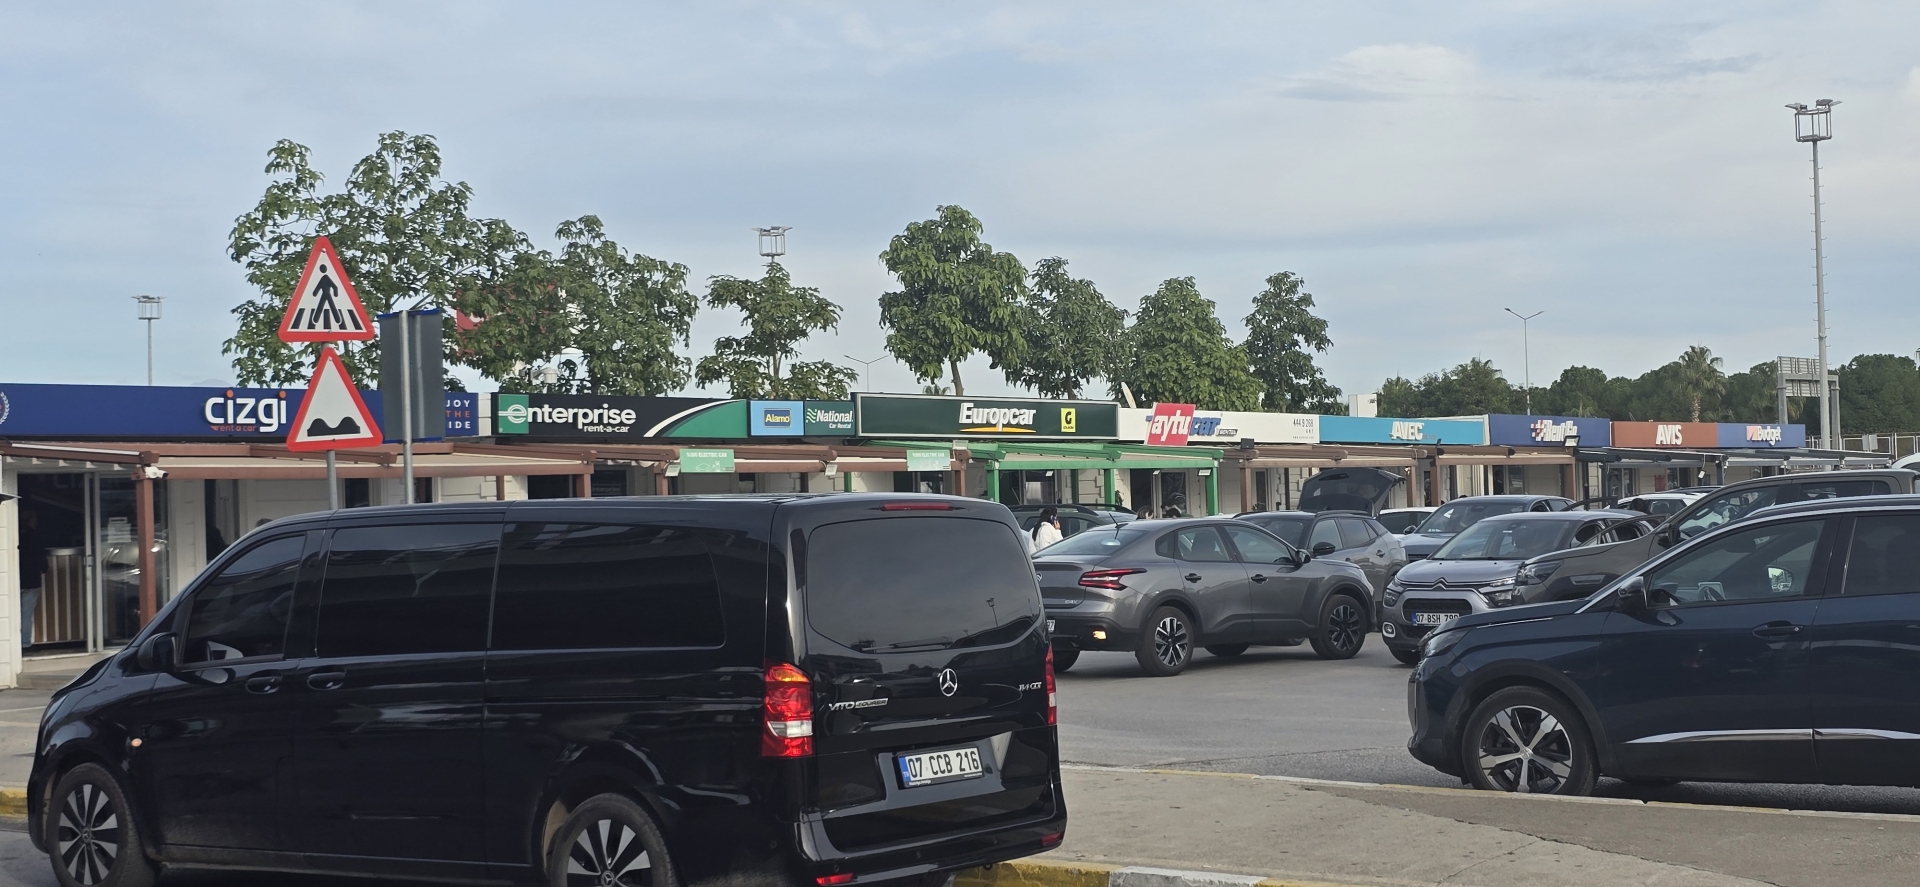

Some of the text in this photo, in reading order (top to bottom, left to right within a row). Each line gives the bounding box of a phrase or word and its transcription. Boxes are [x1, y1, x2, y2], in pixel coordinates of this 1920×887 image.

[204, 389, 287, 433] cizgi
[445, 410, 471, 418] THE
[499, 403, 637, 429] enterprise
[765, 413, 790, 423] Alamo
[959, 402, 1037, 431] Europcar
[216, 424, 235, 432] rent
[243, 424, 257, 432] car
[448, 421, 471, 429] IDE
[583, 423, 630, 433] rent-a-car
[1390, 421, 1425, 440] AVEC
[1655, 425, 1683, 446] AVIS
[1757, 425, 1782, 446] Budget
[1416, 614, 1425, 623] 07
[1427, 614, 1440, 623] BSH
[828, 701, 855, 711] VITO
[907, 750, 980, 778] 07 CCB 216
